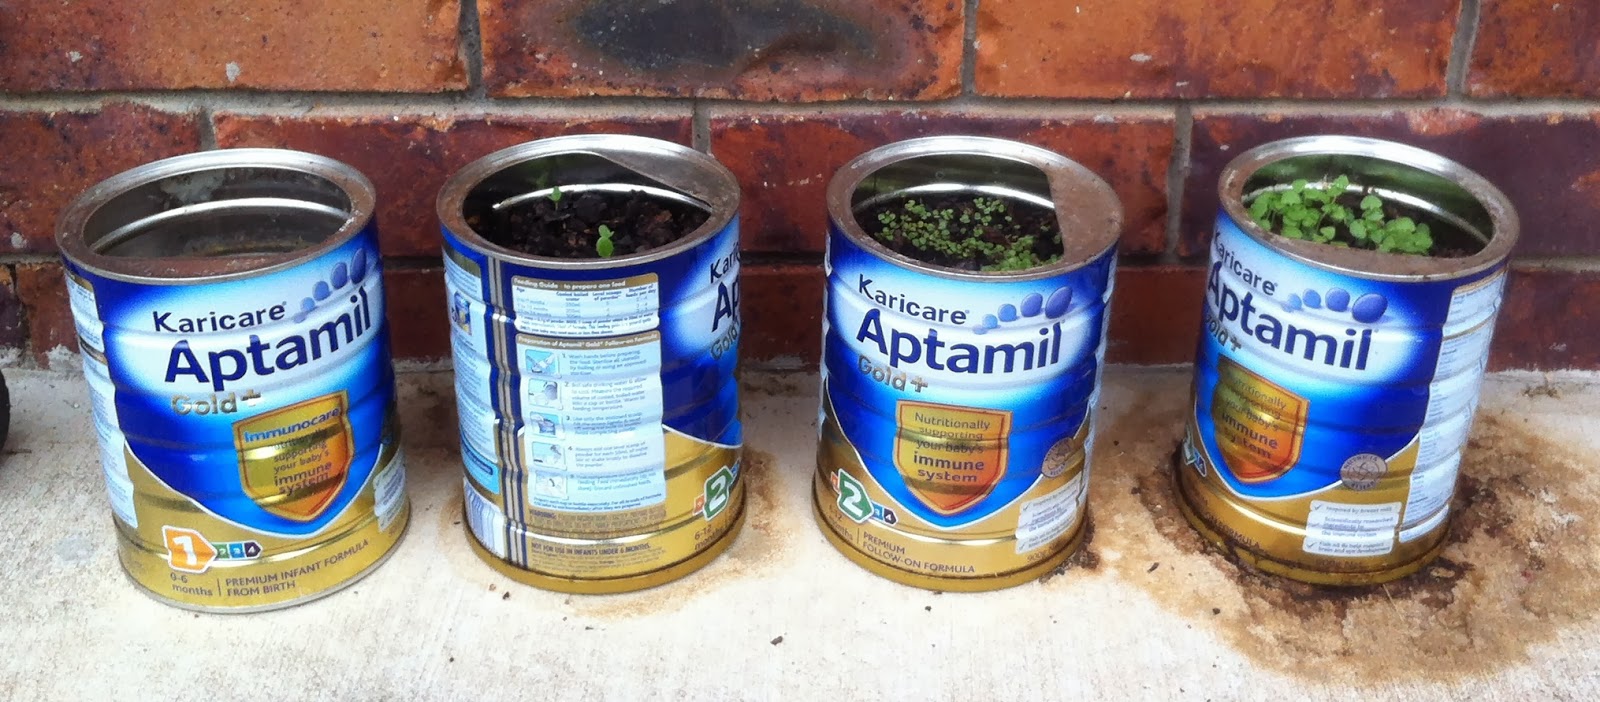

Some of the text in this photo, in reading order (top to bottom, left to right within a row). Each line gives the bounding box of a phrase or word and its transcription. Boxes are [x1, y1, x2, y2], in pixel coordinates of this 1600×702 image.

[513, 277, 539, 289] Feeding
[538, 281, 559, 289] Guide
[611, 280, 626, 288] feed
[858, 273, 968, 325] Karicare
[153, 302, 286, 332] Karicare
[1207, 260, 1373, 371] Aptamil
[165, 286, 371, 392] Aptamil
[856, 308, 1062, 374] Aptamil
[244, 407, 340, 443] Immunocare
[914, 411, 991, 431] Nutritionally
[915, 440, 985, 454] your baby's
[919, 427, 984, 442] supporting
[274, 462, 297, 475] your
[275, 461, 332, 487] immune
[913, 451, 985, 471] immune
[278, 472, 329, 496] system
[917, 468, 978, 483] system
[708, 474, 728, 512] 2
[844, 481, 864, 517] 2
[172, 535, 198, 566] 1
[863, 531, 906, 555] PREMIUM
[225, 538, 370, 587] PREMIUM INFANT FORMULA
[862, 541, 976, 574] FOLLOW-ON FORMULA
[172, 583, 213, 597] months
[226, 579, 296, 597] FROM BIRTH
